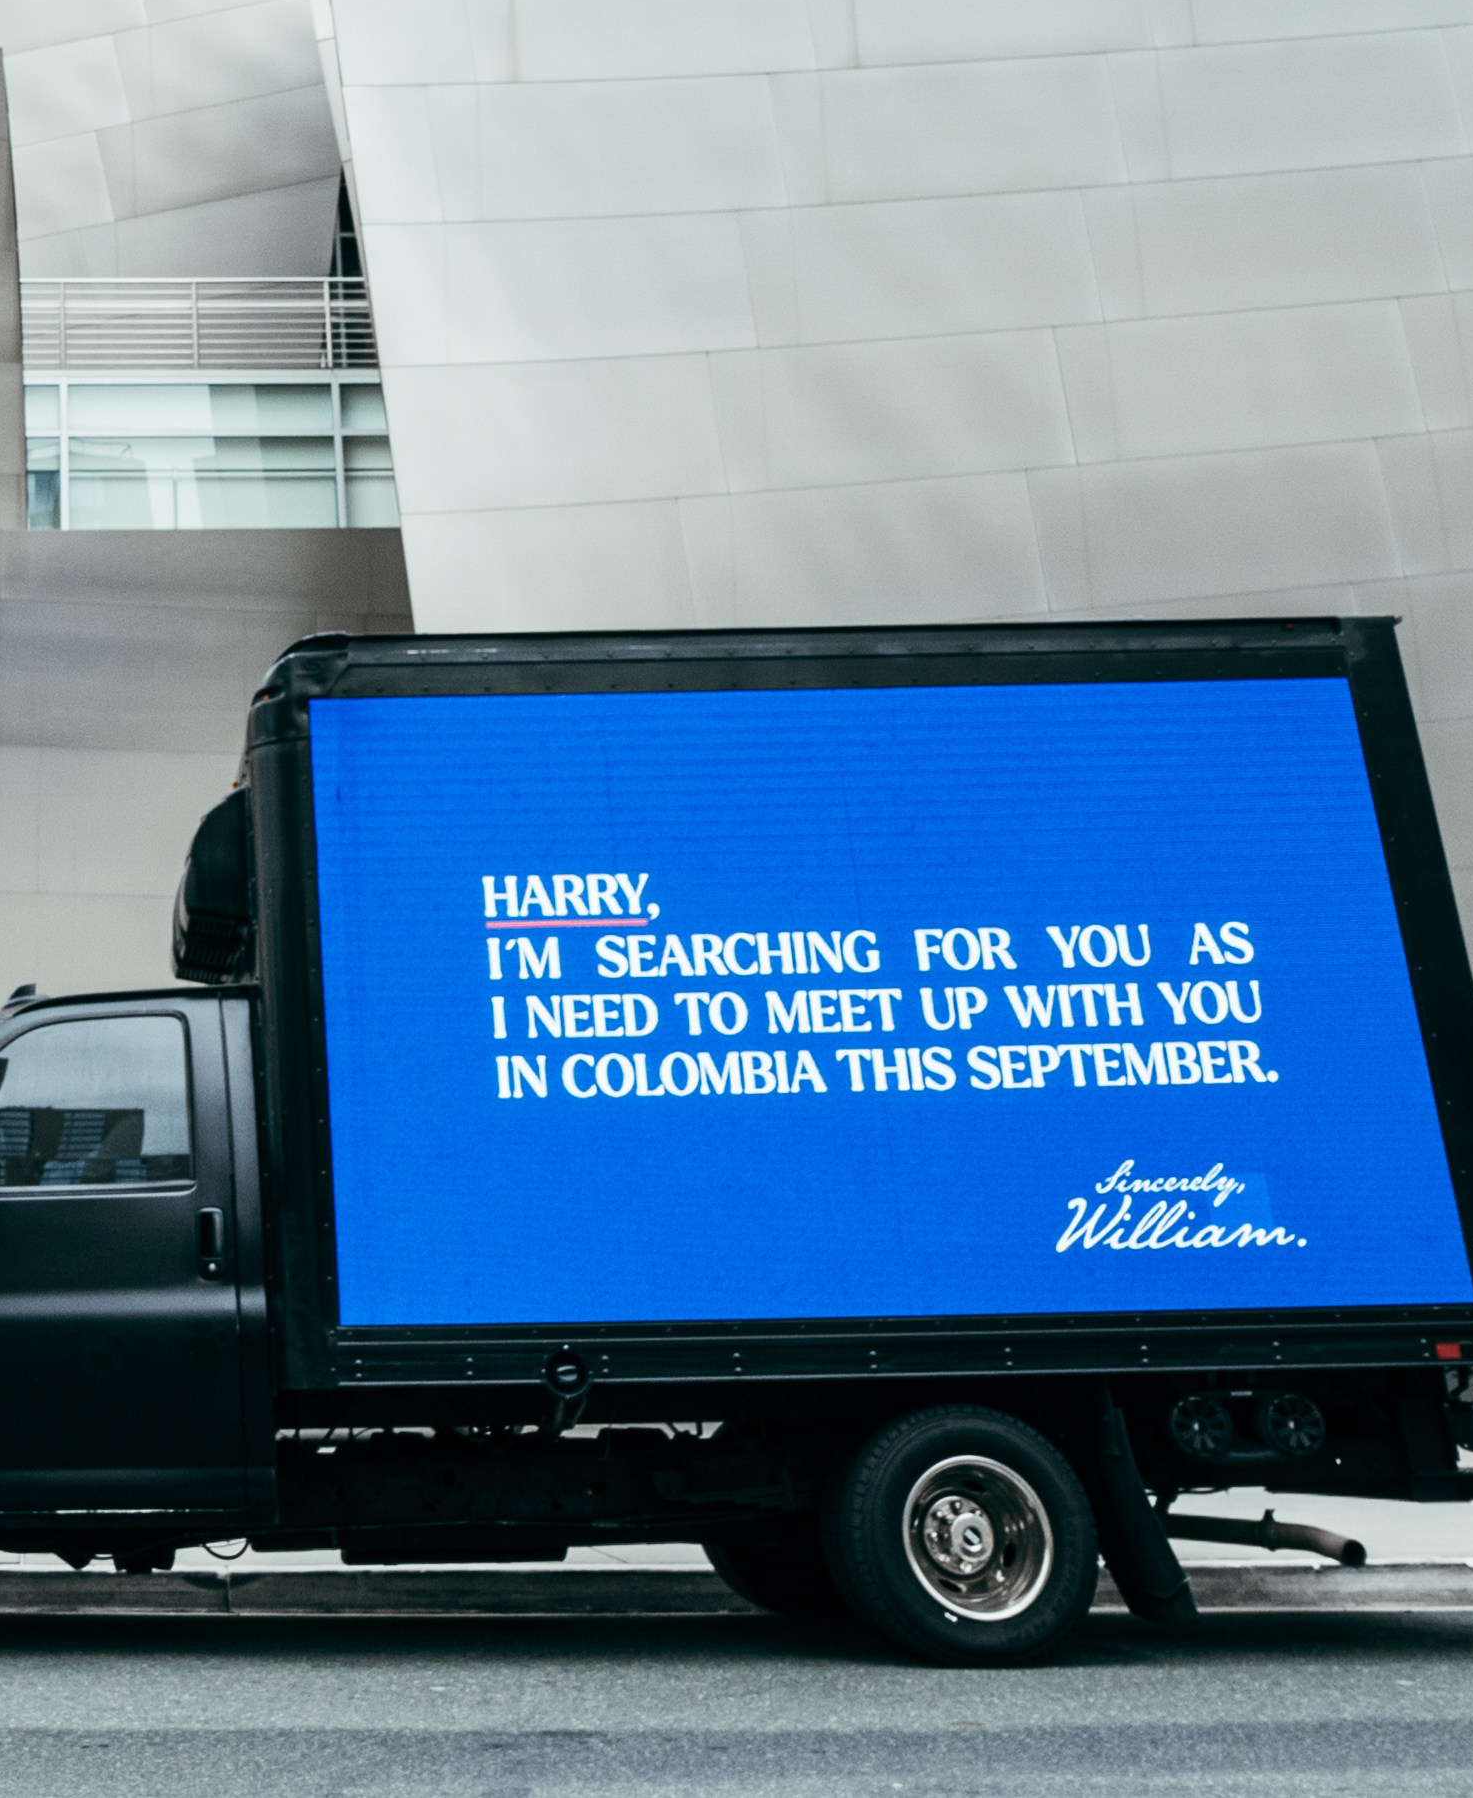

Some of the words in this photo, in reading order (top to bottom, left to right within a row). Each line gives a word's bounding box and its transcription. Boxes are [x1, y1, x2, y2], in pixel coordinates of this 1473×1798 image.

[481, 872, 660, 920] HARRY,
[595, 929, 881, 979] SEARCHING
[913, 927, 1018, 972] FOR
[1045, 923, 1151, 969] YOU
[1189, 921, 1255, 965] AS
[491, 995, 508, 1039] I
[525, 993, 659, 1039] NEED
[673, 991, 749, 1036] TO
[764, 987, 902, 1034] MEET
[919, 986, 988, 1031] UP
[1003, 982, 1144, 1029] WITH
[1156, 979, 1262, 1025] YOU
[495, 1054, 548, 1099] IN
[561, 1049, 828, 1099] COLOMBIA
[835, 1046, 957, 1092] THIS
[966, 1040, 1280, 1091] SEPTEMBER.
[1095, 1159, 1246, 1208] Sincerely,
[1055, 1194, 1307, 1253] William.
